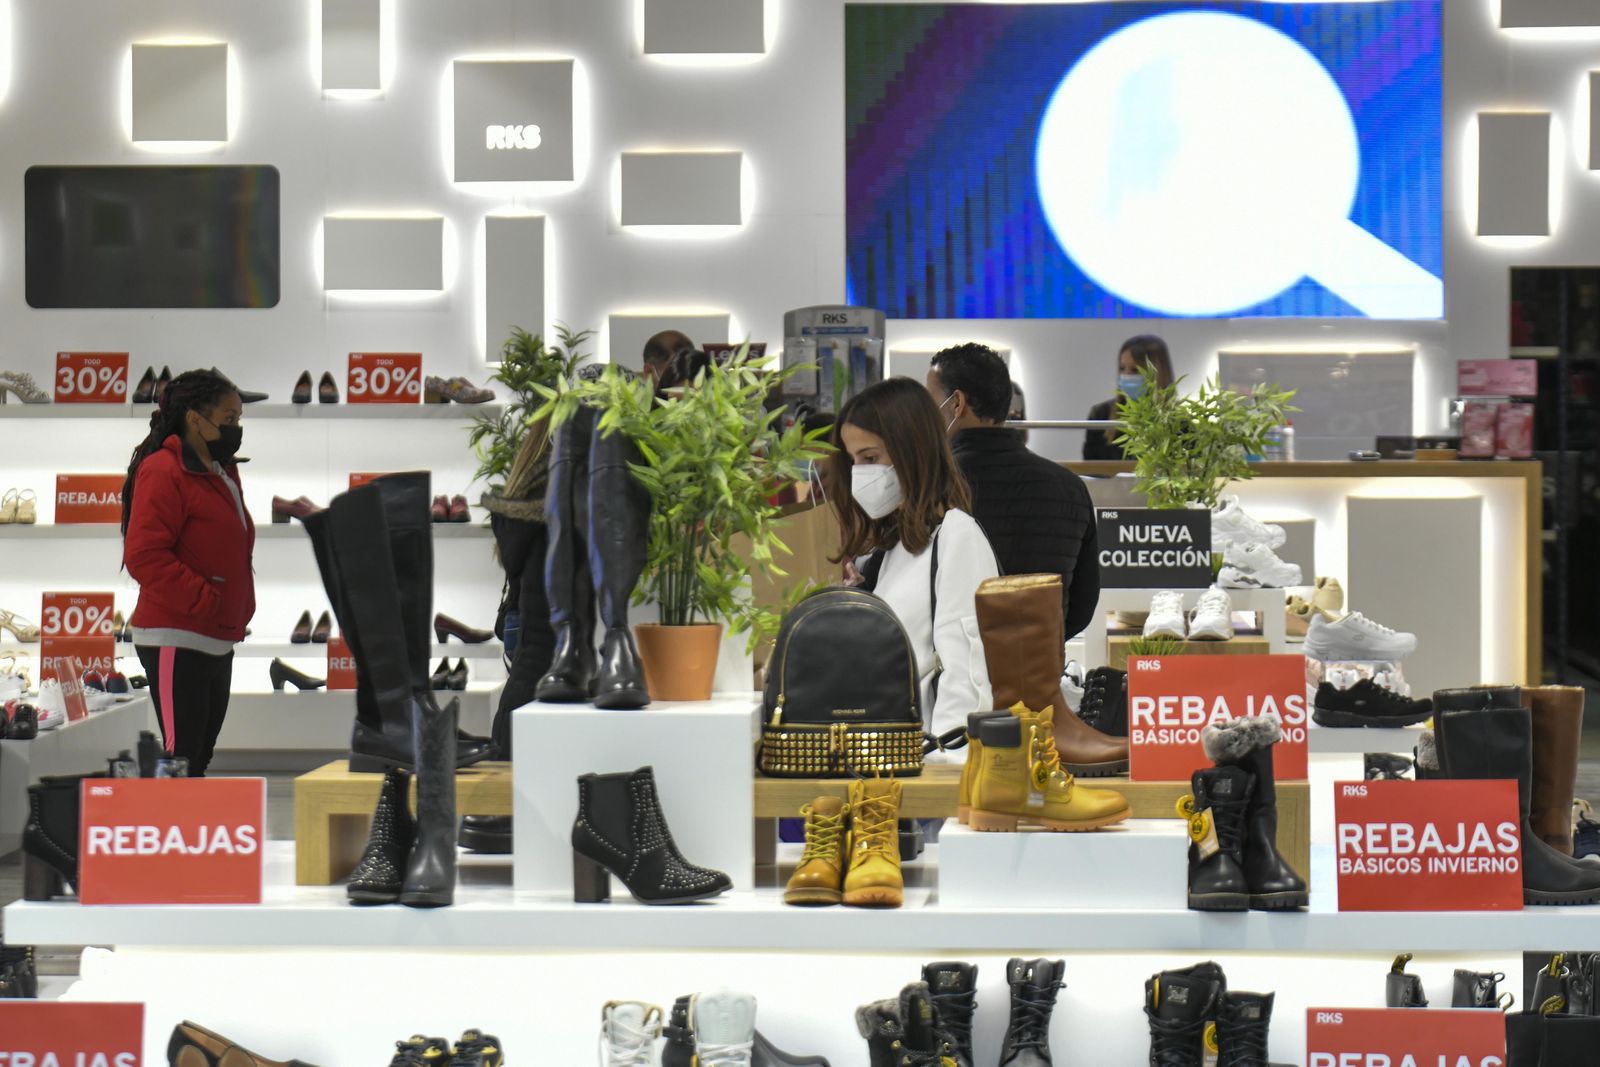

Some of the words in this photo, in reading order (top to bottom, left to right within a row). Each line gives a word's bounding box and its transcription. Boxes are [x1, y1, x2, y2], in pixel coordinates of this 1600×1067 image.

[486, 124, 542, 150] RKS
[822, 313, 848, 324] RKS
[57, 366, 127, 395] 30%
[349, 366, 421, 395] 30%
[1101, 511, 1119, 519] RKS
[1119, 525, 1193, 543] NUEVA
[1098, 545, 1211, 567] COLECCIÓN
[43, 606, 115, 634] 30%
[1136, 660, 1161, 671] RKS
[1131, 694, 1307, 726] REBAJAS
[1132, 725, 1200, 745] BÁSICO
[91, 786, 113, 796] RKS
[1343, 785, 1368, 796] RKS
[87, 824, 258, 855] REBAJAS
[1338, 822, 1520, 854] REBAJAS
[1339, 853, 1422, 874] BÁSICOS
[1428, 856, 1519, 874] INVIERNO
[1316, 1012, 1344, 1024] RKS
